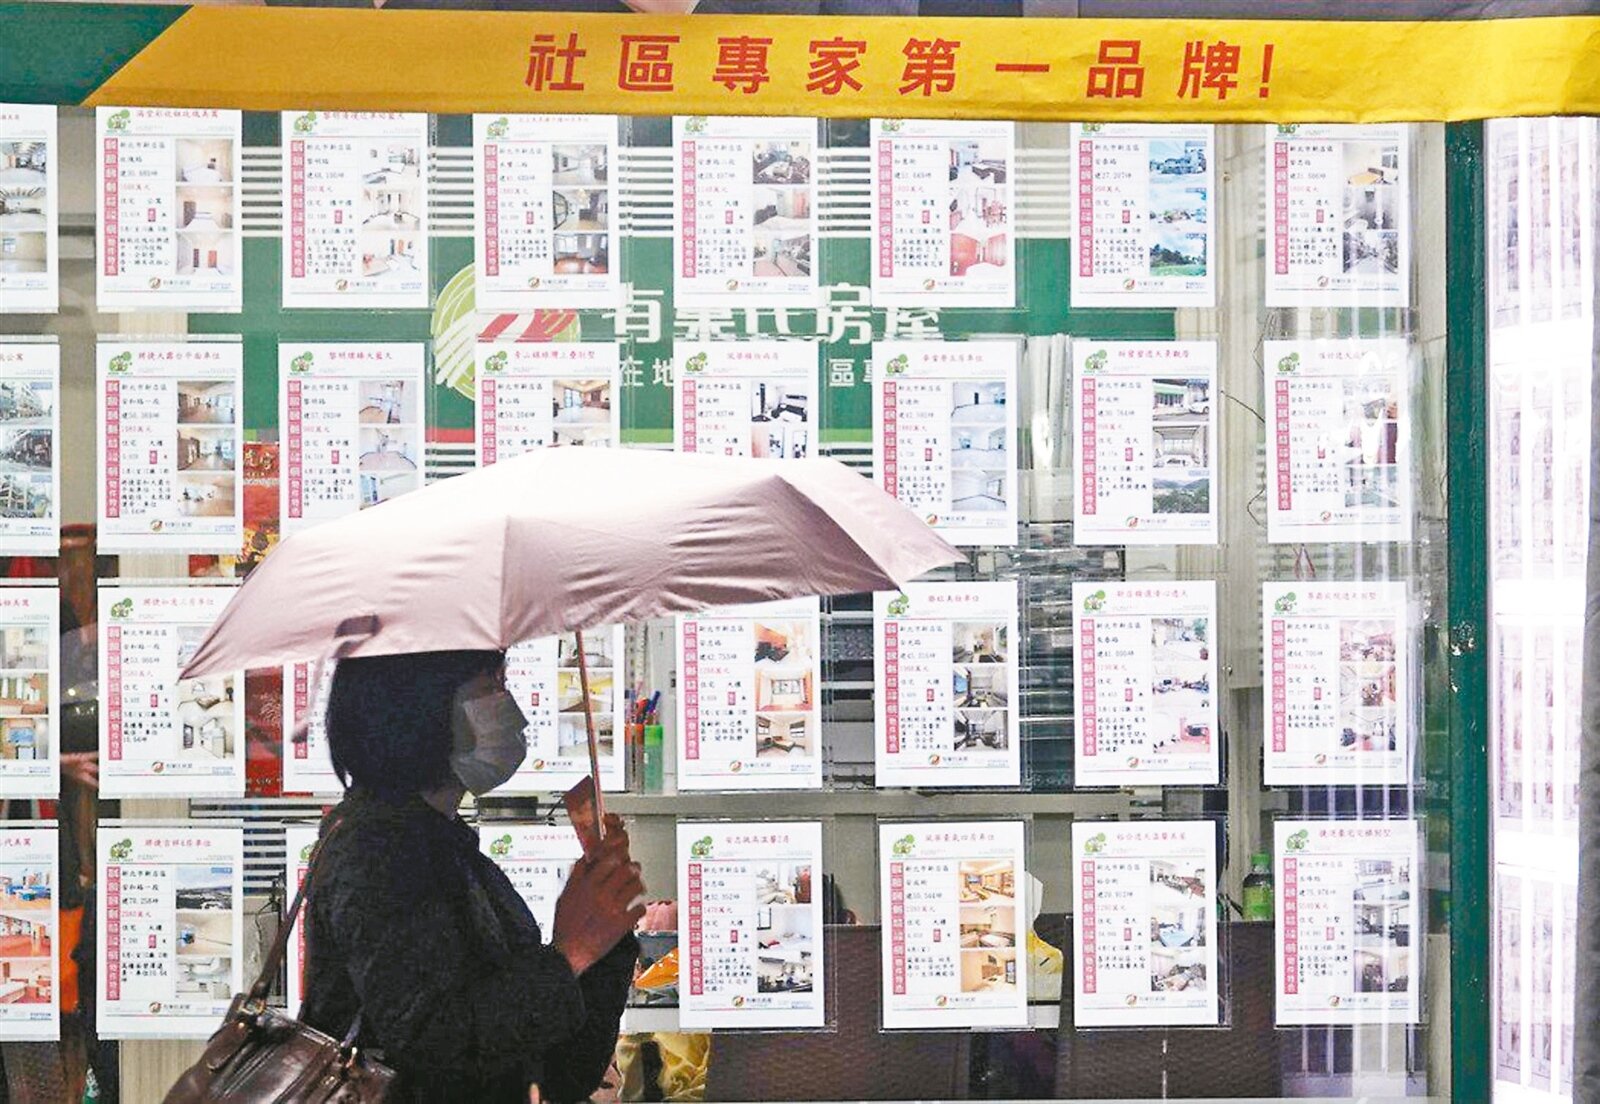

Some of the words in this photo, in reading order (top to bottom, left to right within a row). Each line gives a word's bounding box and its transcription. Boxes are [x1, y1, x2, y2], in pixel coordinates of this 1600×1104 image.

[526, 33, 1273, 99] 社區專家第一品牌!
